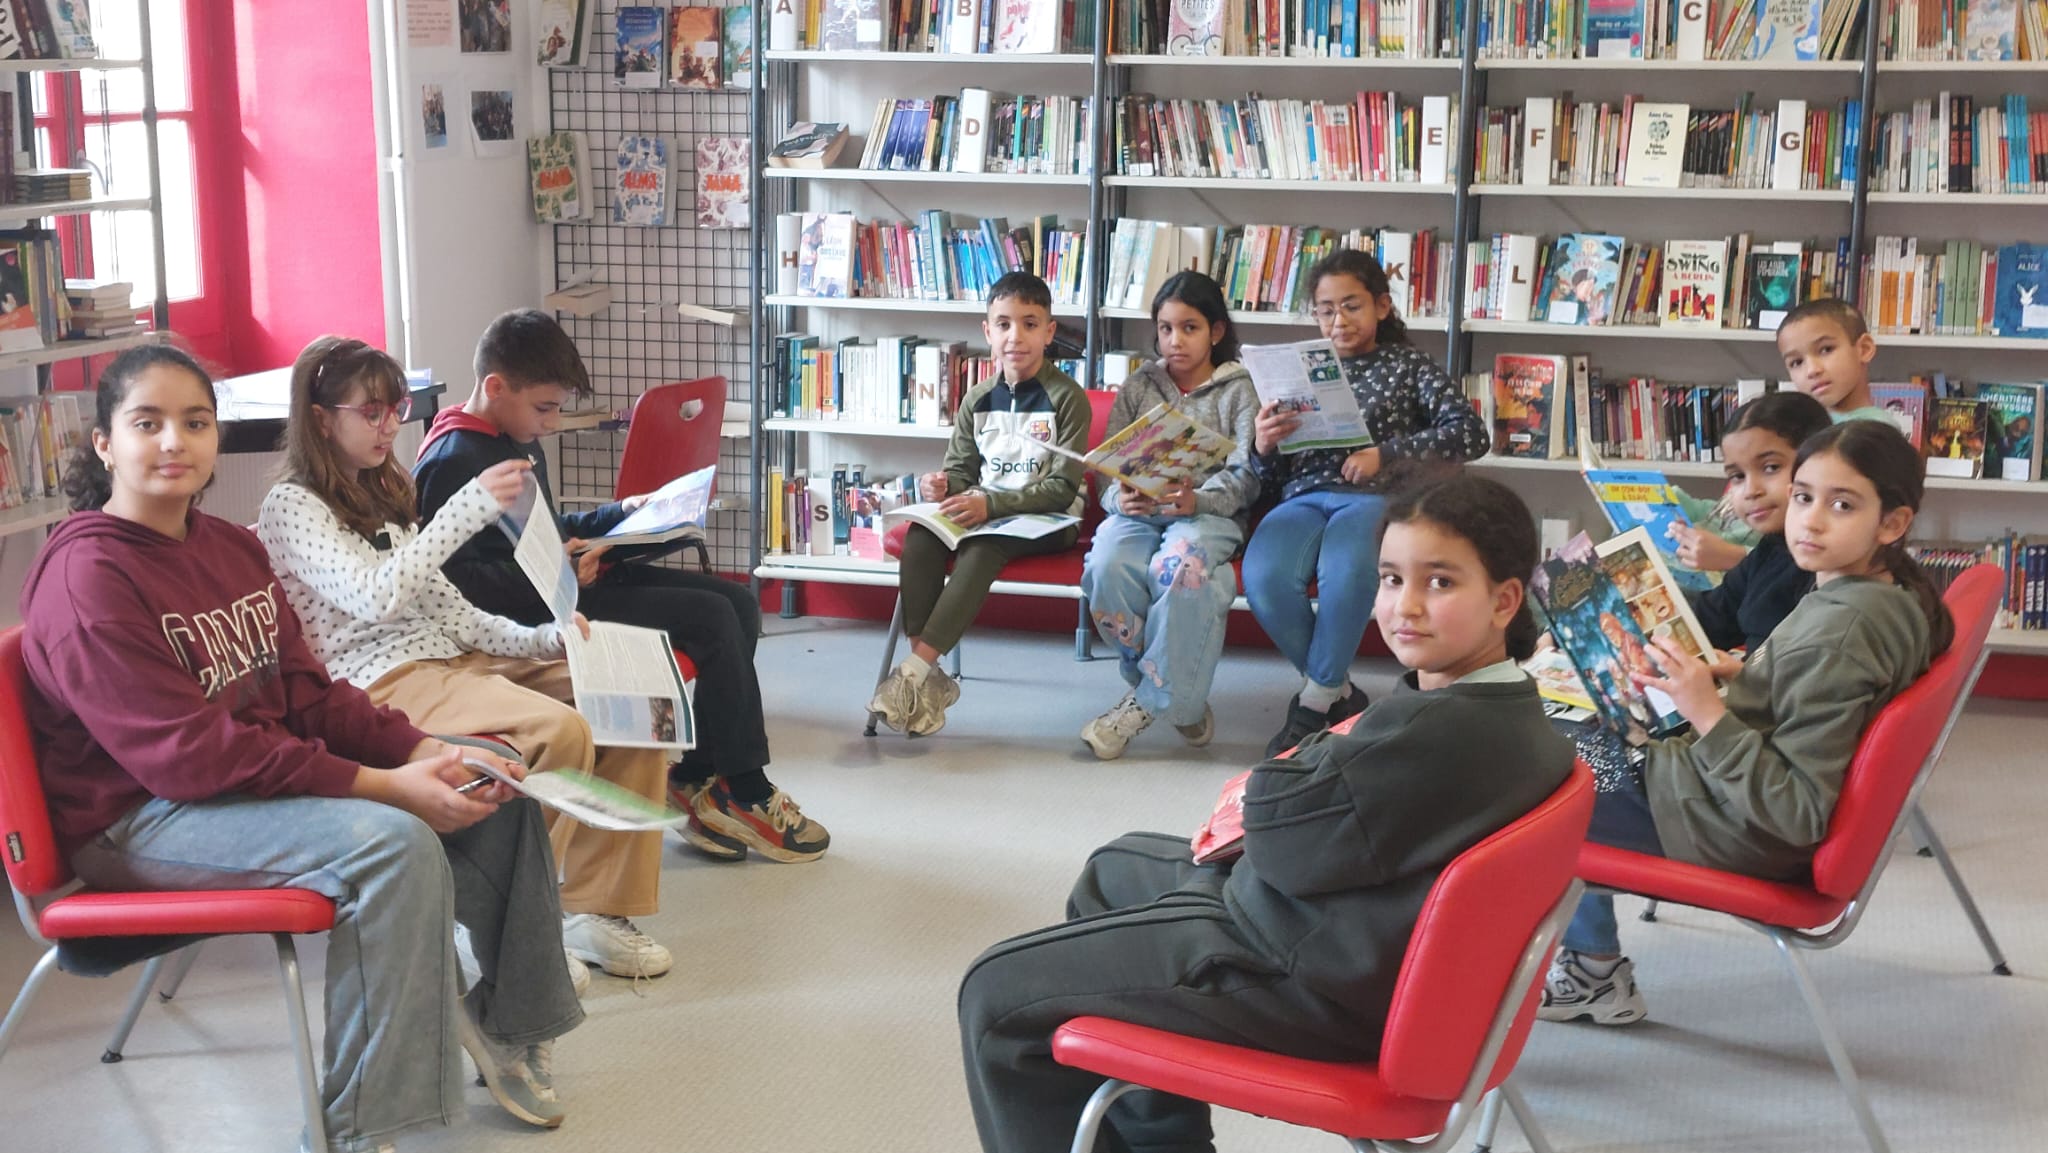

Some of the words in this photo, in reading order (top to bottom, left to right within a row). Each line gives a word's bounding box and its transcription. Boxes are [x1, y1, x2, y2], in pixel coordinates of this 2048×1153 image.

[776, 0, 792, 14] A
[957, 0, 972, 16] B
[1683, 2, 1701, 21] C
[965, 118, 980, 136] D
[1428, 127, 1443, 146] E
[1531, 128, 1546, 147] F
[1780, 132, 1800, 150] G
[782, 251, 797, 267] H
[1666, 258, 1720, 273] SWING
[1386, 262, 1404, 280] K
[1511, 265, 1526, 284] L
[918, 383, 935, 400] N
[990, 457, 1045, 476] Spotify
[814, 505, 828, 522] S
[161, 581, 278, 699] CAMP
